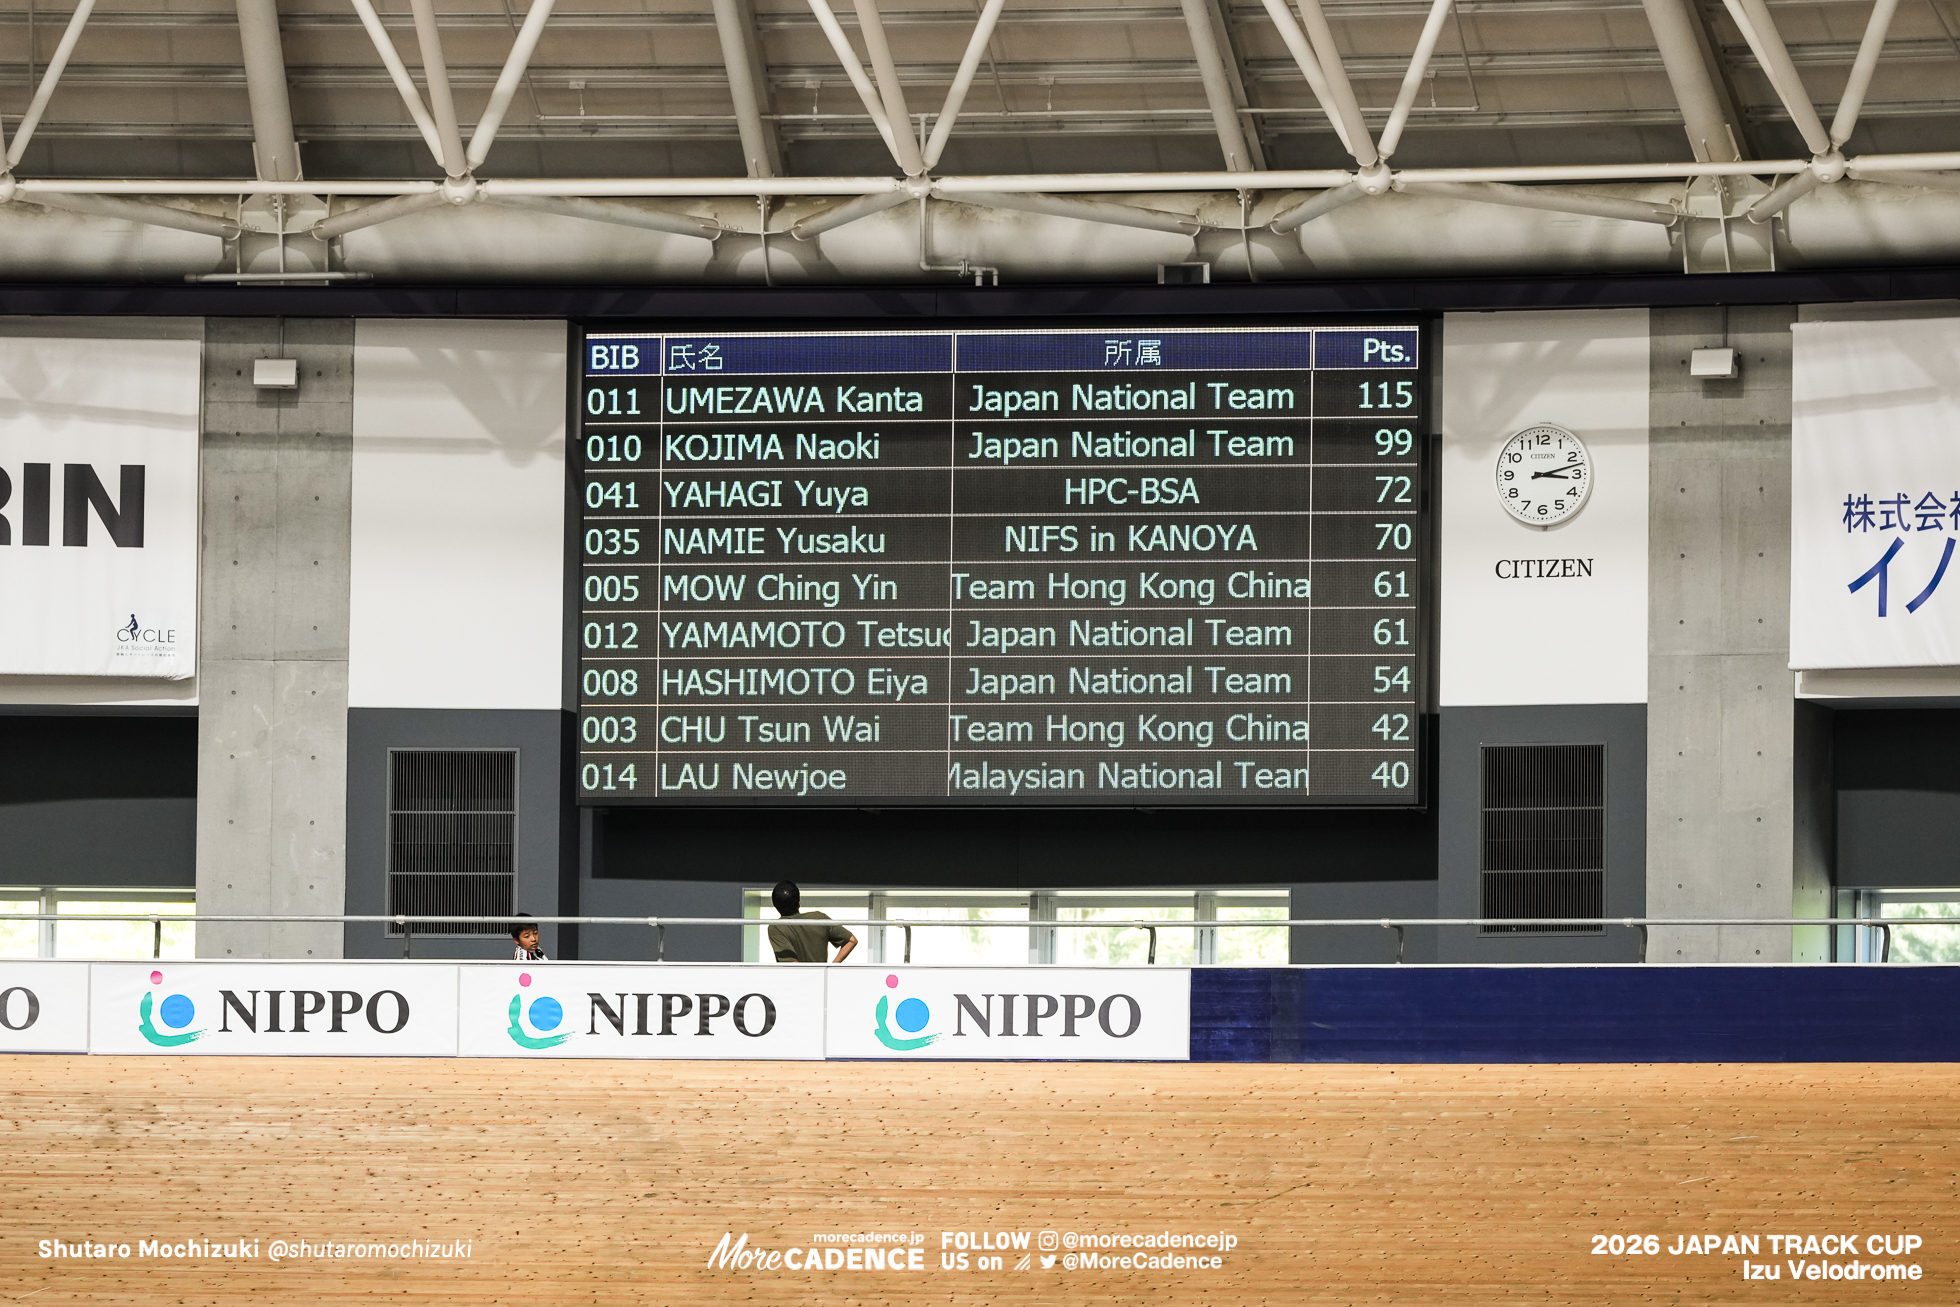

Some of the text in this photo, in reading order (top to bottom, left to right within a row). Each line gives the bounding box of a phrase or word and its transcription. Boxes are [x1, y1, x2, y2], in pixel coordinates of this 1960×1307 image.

[592, 345, 639, 369] BIB
[669, 343, 722, 370] 氏名
[1105, 340, 1161, 366] 所属
[1364, 338, 1410, 362] Pts.
[588, 389, 640, 414] 011
[667, 386, 922, 414] UMEZAWA Kanta
[969, 382, 1293, 417] Japan National Team
[1359, 382, 1412, 408] 115
[587, 435, 641, 461] 010
[666, 432, 879, 460] KOJIMA Naoki
[969, 429, 1293, 464] Japan National Team
[1375, 429, 1412, 455] 99
[1520, 440, 1531, 450] 11
[1536, 435, 1550, 445] 12
[1558, 439, 1561, 449] 1
[1508, 453, 1522, 463] 10
[1567, 452, 1577, 462] 2
[1504, 471, 1514, 480] 9
[1572, 469, 1581, 479] 3
[587, 482, 638, 508] 041
[664, 480, 868, 513] YAHAGI Yuya
[1066, 478, 1199, 504] HPC-BSA
[1376, 476, 1411, 502] 72
[1509, 488, 1518, 498] 8
[1566, 487, 1577, 496] 4
[0, 463, 145, 548] IN
[1521, 501, 1531, 510] 7
[1538, 505, 1547, 515] 6
[1555, 500, 1564, 510] 5
[586, 529, 639, 554] 035
[665, 526, 884, 554] NAMIE Yusaku
[1006, 525, 1257, 552] NIFS in KANOYA
[1376, 524, 1411, 550] 70
[1496, 559, 1593, 578] CITIZEN
[585, 576, 639, 601] 005
[665, 573, 897, 607] MOW Ching Yin
[952, 571, 1309, 605] Team Hong Kong China
[1375, 571, 1409, 597] 61
[117, 629, 175, 642] CYCLE
[584, 622, 638, 648] 012
[662, 621, 845, 648] YAMAMOTO
[967, 618, 1291, 653] Japan National Team
[1374, 619, 1409, 644] 61
[584, 669, 637, 696] 008
[663, 668, 927, 701] HASHIMOTO Eiya
[966, 666, 1290, 700] Japan National Team
[1374, 666, 1411, 693] 54
[583, 717, 636, 743] 003
[661, 716, 879, 742] CHU Tsun Wai
[950, 713, 1308, 747] Team Hong Kong China
[1372, 714, 1409, 740] 42
[582, 763, 637, 790] 014
[662, 763, 847, 796] LAU Newjoe
[1099, 761, 1221, 788] National
[1372, 761, 1409, 788] 40
[219, 990, 409, 1033] NIPPO
[586, 993, 776, 1037] NIPPO
[953, 994, 1141, 1038] NIPPO
